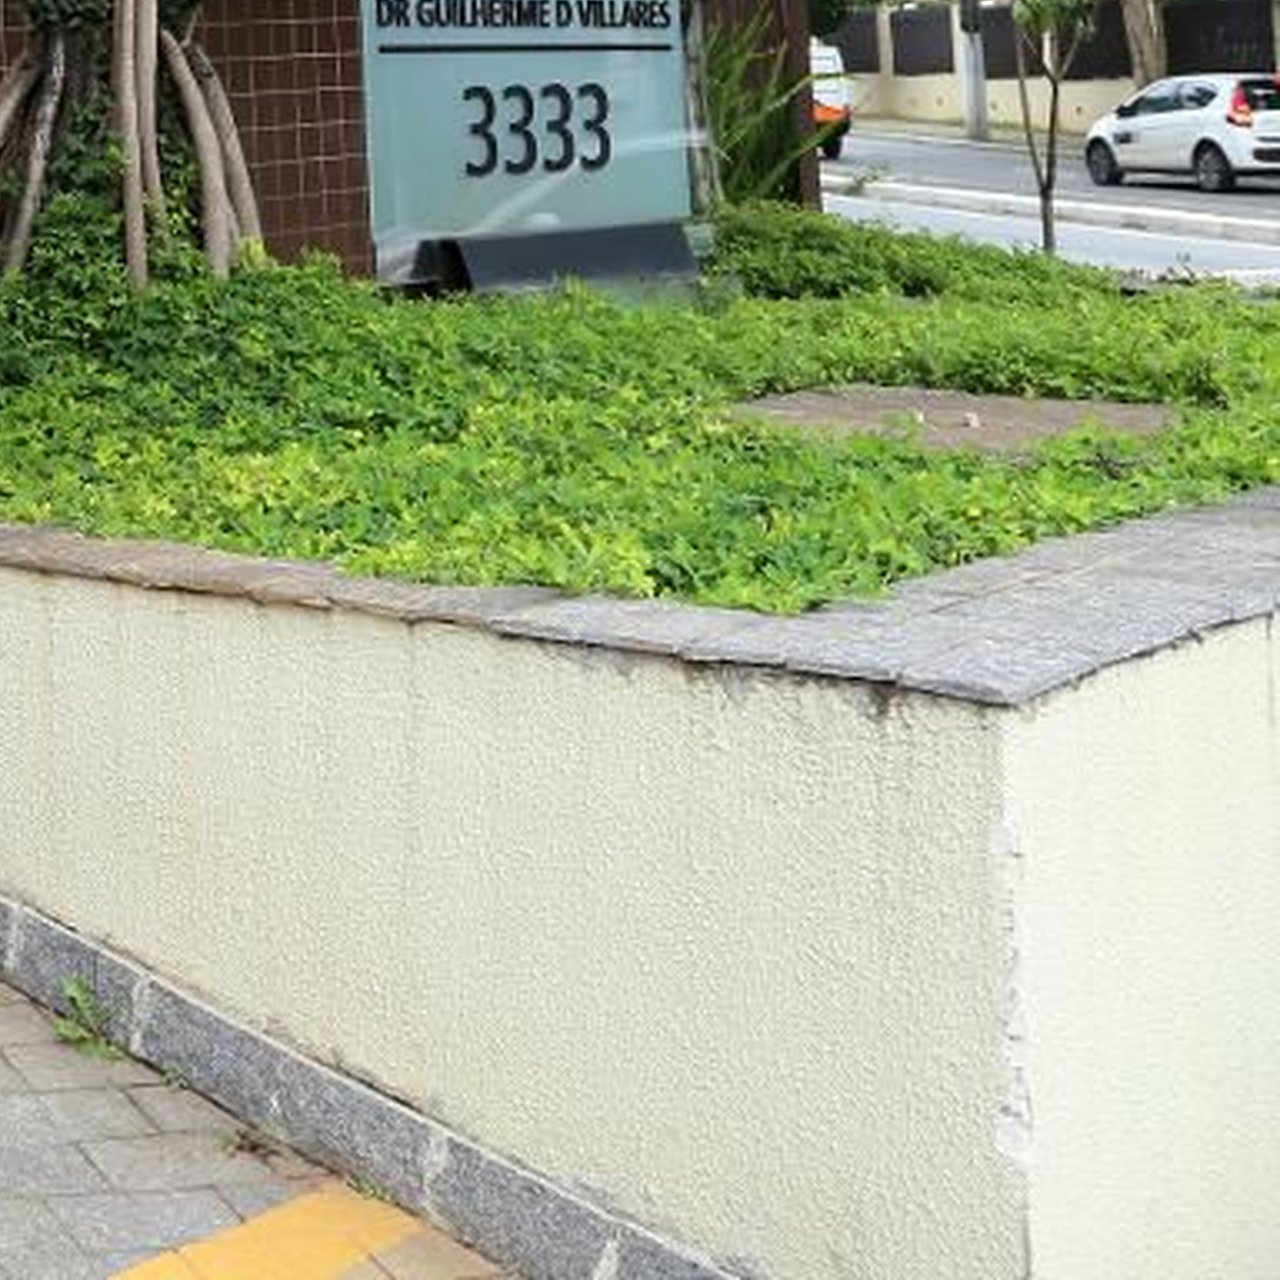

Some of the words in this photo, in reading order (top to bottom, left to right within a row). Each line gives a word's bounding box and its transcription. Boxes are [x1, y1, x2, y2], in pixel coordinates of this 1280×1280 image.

[555, 0, 572, 28] D
[575, 0, 672, 29] VILLARES
[461, 82, 612, 178] 3333
